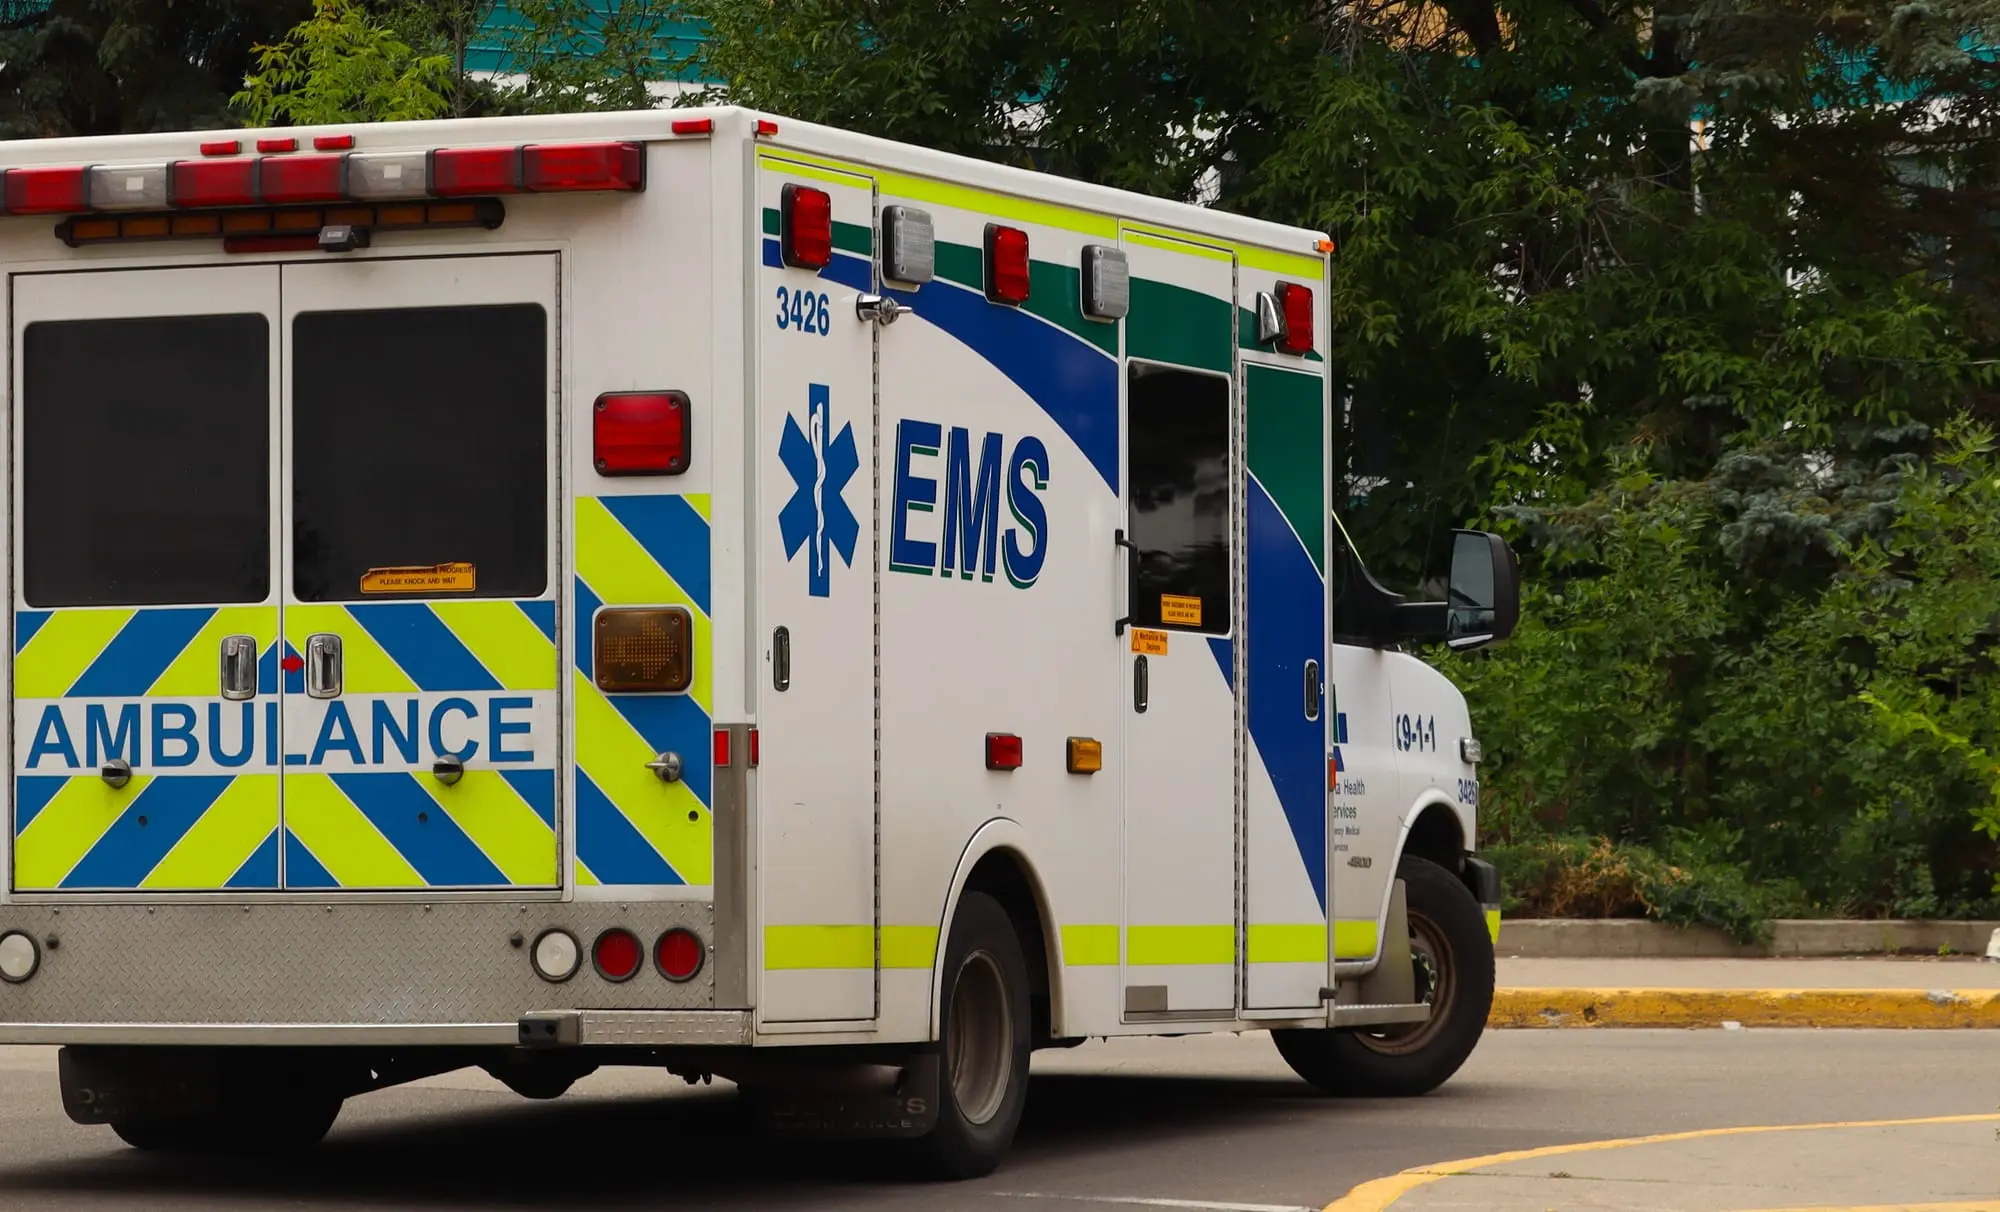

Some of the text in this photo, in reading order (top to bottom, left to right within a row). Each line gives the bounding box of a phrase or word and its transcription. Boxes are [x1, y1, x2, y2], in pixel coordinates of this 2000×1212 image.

[776, 286, 830, 336] 3426
[889, 418, 1050, 589] EMS
[442, 576, 456, 584] WAIT
[25, 697, 535, 769] AMBULANCE
[1343, 778, 1365, 795] Health
[1333, 802, 1357, 819] ervices
